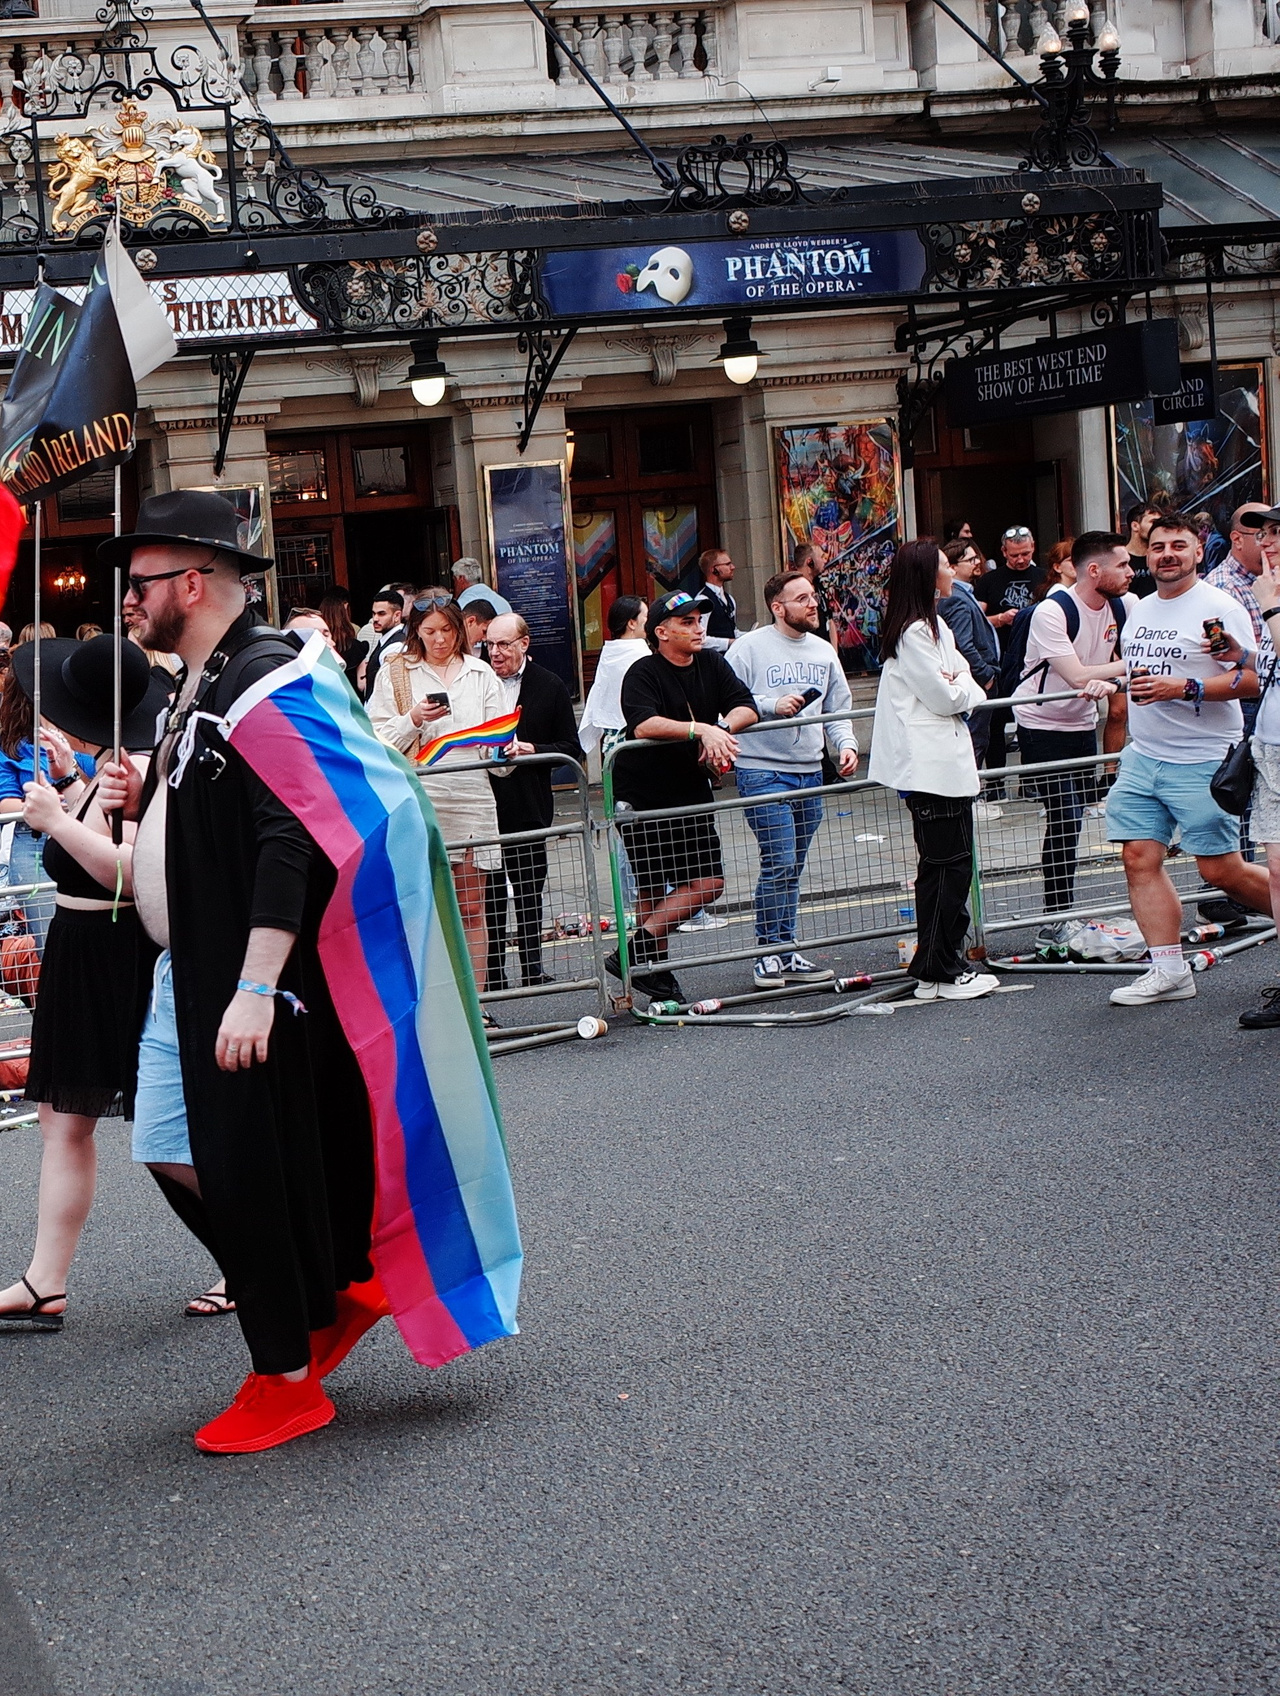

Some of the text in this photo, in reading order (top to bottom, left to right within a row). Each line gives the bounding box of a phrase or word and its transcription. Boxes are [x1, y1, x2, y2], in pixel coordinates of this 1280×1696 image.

[180, 200, 212, 222] DROIT
[750, 241, 781, 250] ANDREW
[783, 240, 808, 248] LLOYD
[725, 248, 872, 281] PHANTOM
[746, 280, 855, 298] OF THE OPERA
[166, 294, 297, 332] THEATRE
[975, 343, 1107, 383] THE BEST WEST END
[977, 380, 1014, 402] SHOW
[1018, 376, 1035, 395] OF
[1039, 372, 1064, 391] ALL
[1162, 393, 1205, 411] CIRCLE
[20, 450, 51, 490] AND
[40, 412, 131, 477] IRELAND
[500, 542, 560, 558] PHANTOM
[1134, 626, 1178, 641] Dance
[1146, 643, 1188, 661] Love,
[766, 662, 827, 689] CALIF
